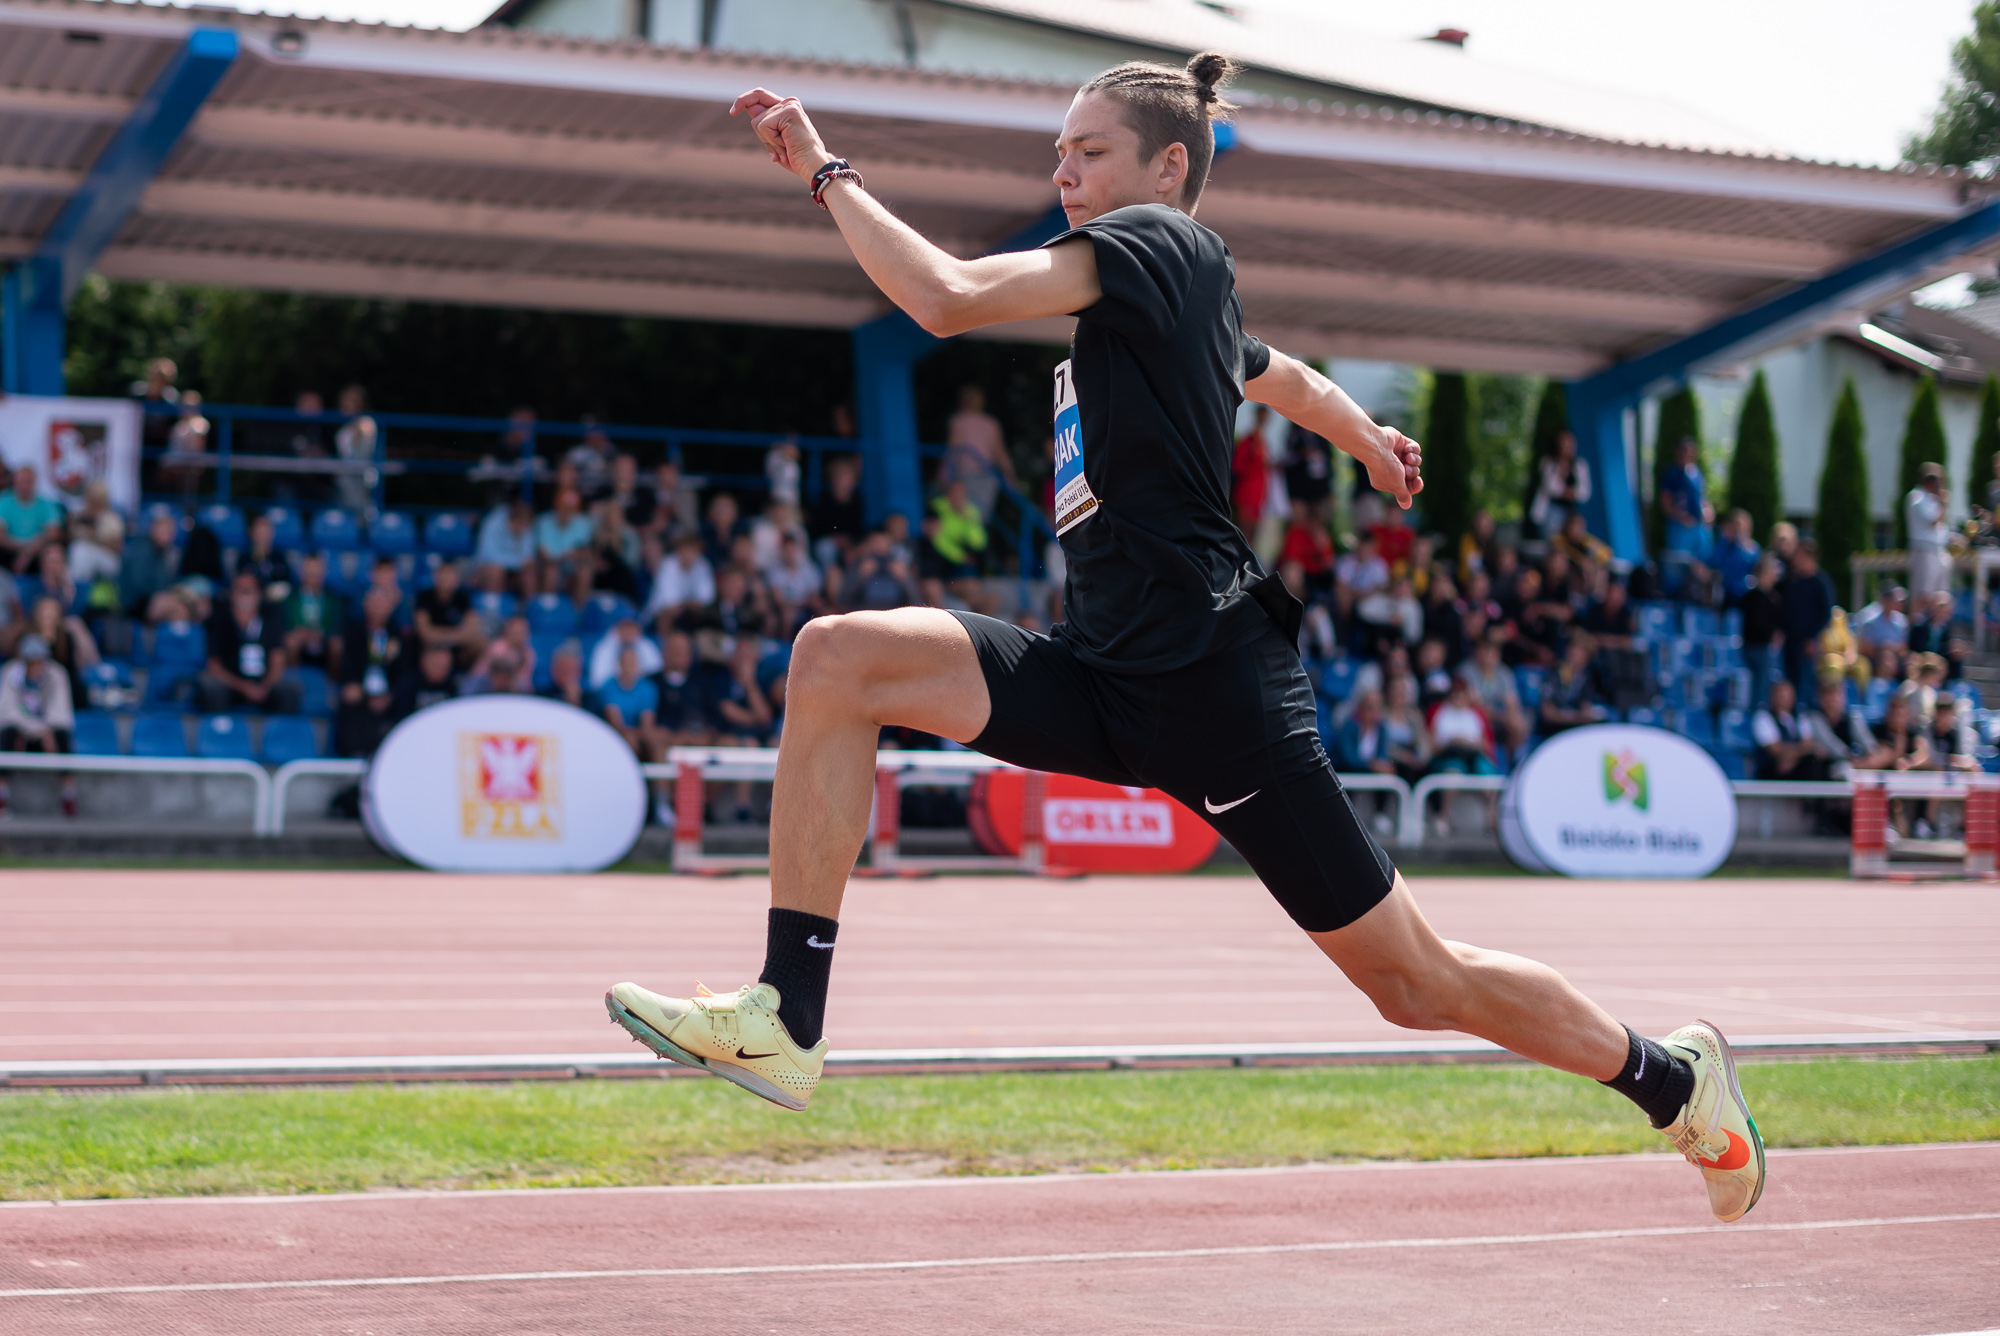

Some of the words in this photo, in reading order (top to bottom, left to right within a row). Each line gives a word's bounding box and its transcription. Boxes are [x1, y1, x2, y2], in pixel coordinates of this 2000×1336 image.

[1055, 368, 1065, 410] 7
[1063, 485, 1079, 508] Polski
[1077, 483, 1089, 498] U18
[1060, 499, 1096, 527] 15-17.07.2022
